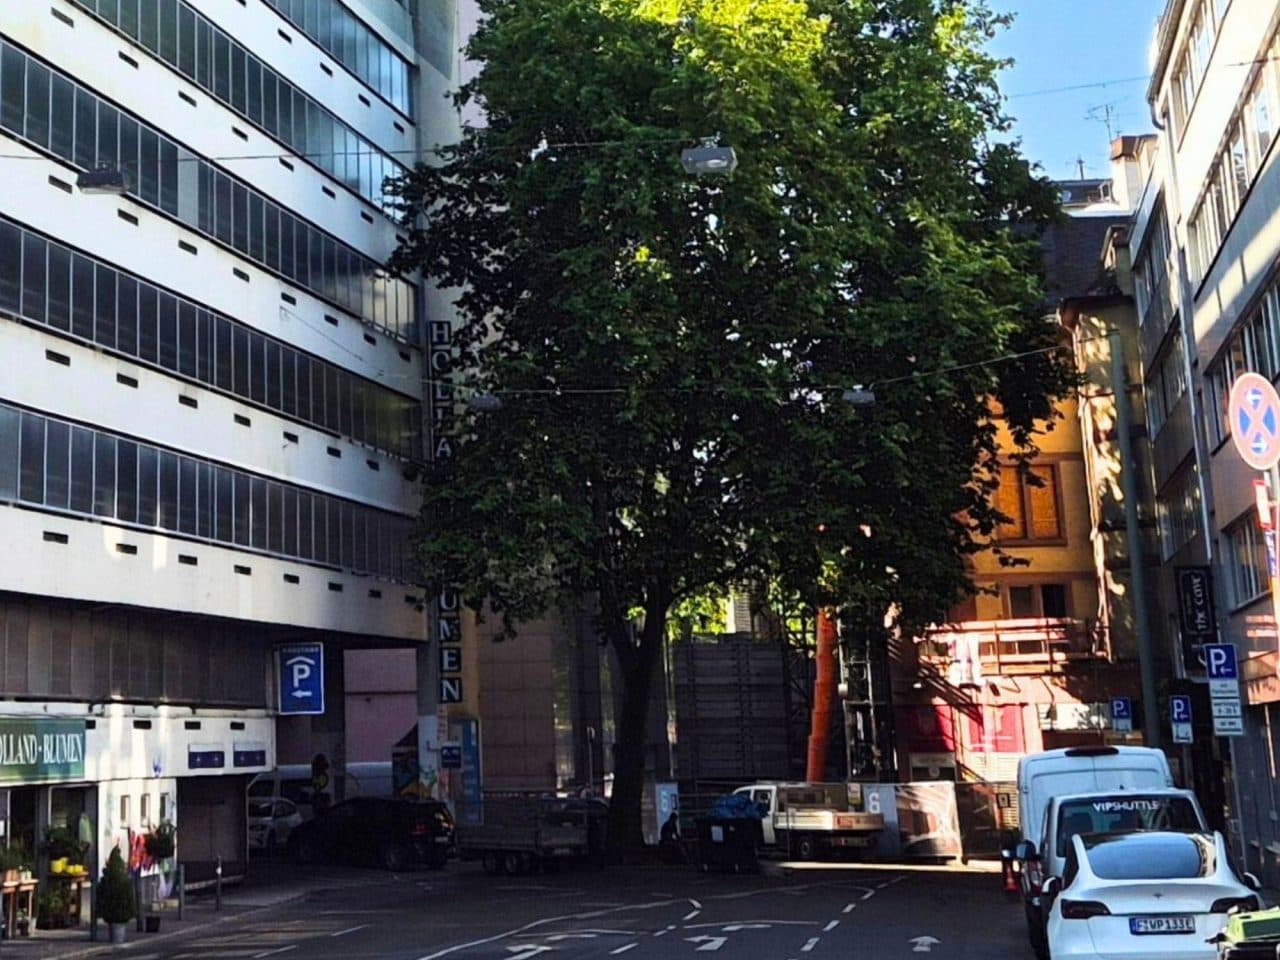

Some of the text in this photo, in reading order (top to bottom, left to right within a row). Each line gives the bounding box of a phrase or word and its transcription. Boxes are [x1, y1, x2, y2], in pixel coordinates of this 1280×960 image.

[1209, 648, 1227, 676] P
[293, 664, 311, 688] P
[1112, 700, 1124, 716] P
[1173, 699, 1185, 719] P
[42, 732, 84, 763] BLUMEN
